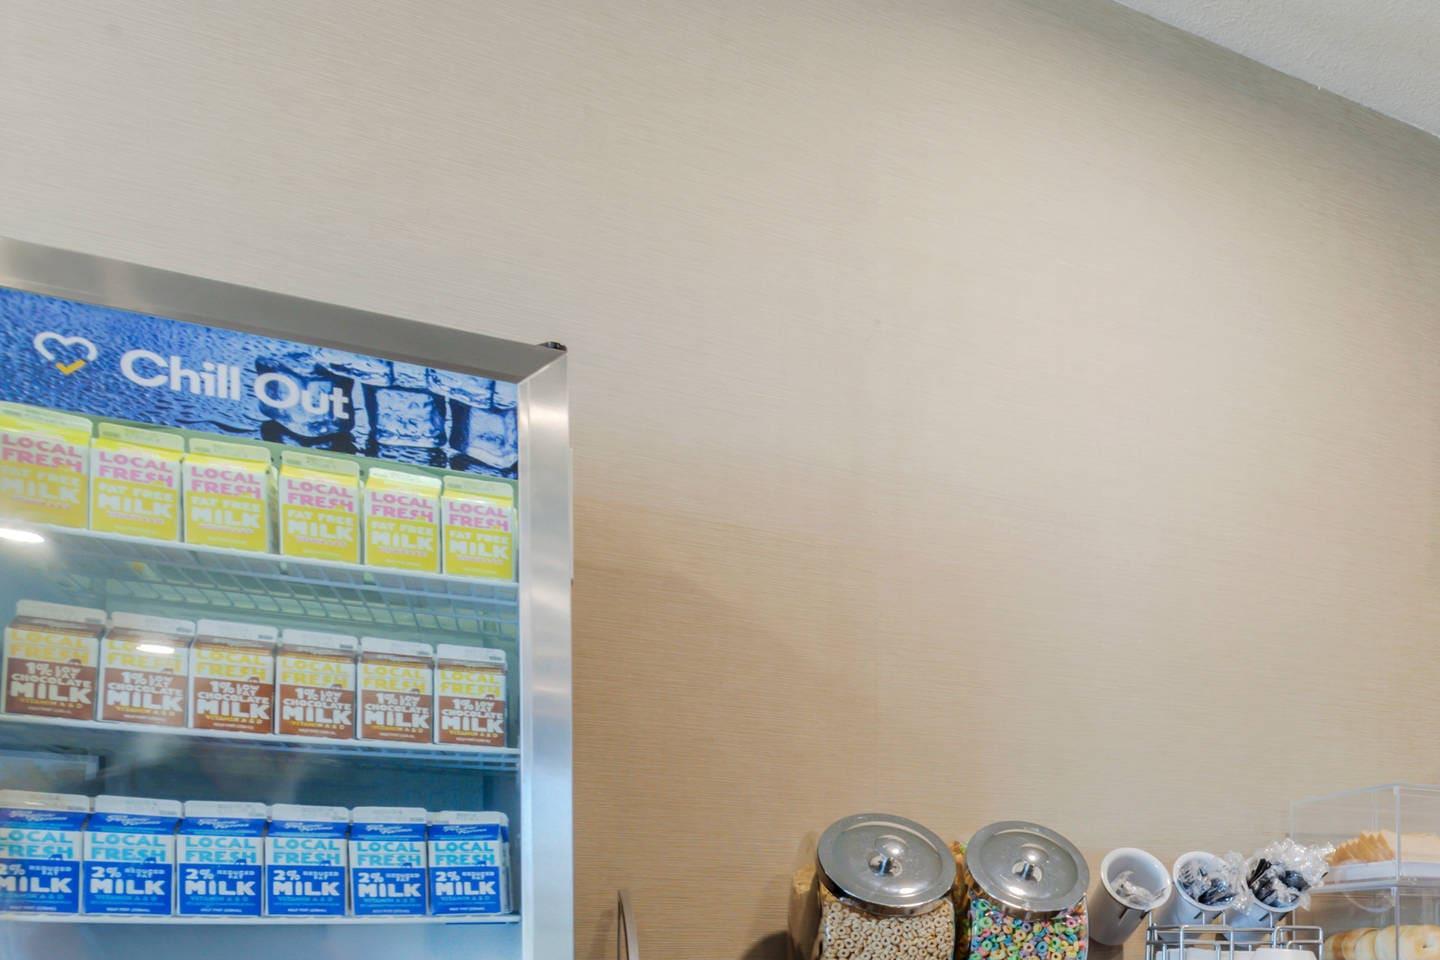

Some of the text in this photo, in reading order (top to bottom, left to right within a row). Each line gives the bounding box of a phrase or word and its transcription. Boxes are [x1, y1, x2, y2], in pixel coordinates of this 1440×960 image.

[120, 349, 348, 420] Chill Out
[2, 434, 82, 458] LOCAL
[99, 451, 173, 472] LOCAL
[191, 466, 261, 485] LOCAL
[0, 476, 80, 505] MILK
[288, 479, 353, 498] LOCAL
[99, 493, 173, 518] MILK
[371, 491, 433, 509] LOCAL
[449, 501, 508, 518] LOCAL
[191, 506, 261, 529] MILK
[287, 519, 353, 542] MILK
[371, 531, 433, 552] MILK
[450, 539, 509, 559] MILK
[11, 631, 86, 648] LOCAL
[196, 648, 265, 666] LOCAL
[282, 656, 345, 673] LOCAL
[26, 662, 53, 677] 1%
[363, 665, 425, 679] LOCAL
[441, 670, 500, 683] LOCAL
[11, 673, 92, 688] CHOCOLATE
[121, 672, 147, 685] 1%
[10, 681, 92, 704] MILK
[107, 682, 183, 697] CHOCOLATE
[209, 681, 234, 693] 1%
[295, 688, 318, 700] 1%
[106, 689, 183, 712] MILK
[198, 691, 269, 705] CHOCOLATE
[283, 698, 352, 711] CHOCOLATE
[376, 693, 399, 705] 1%
[453, 699, 474, 710] 1%
[197, 699, 270, 720] MILK
[283, 704, 352, 725] MILK
[365, 704, 430, 715] CHOCOLATE
[442, 709, 503, 720] CHOCOLATE
[364, 710, 430, 729] MILK
[442, 716, 504, 733] MILK
[91, 833, 166, 847] LOCAL
[185, 836, 256, 849] LOCAL
[273, 838, 340, 850] LOCAL
[357, 842, 421, 852] LOCAL
[435, 841, 494, 852] LOCAL
[91, 847, 166, 862] FRESH
[185, 850, 256, 864] FRESH
[273, 851, 340, 865] FRESH
[357, 854, 421, 866] FRESH
[435, 854, 495, 865] FRESH
[0, 863, 26, 875] 2%
[90, 866, 122, 878] 2%
[185, 868, 214, 880] 2%
[273, 869, 300, 881] 2%
[435, 871, 460, 882] 2%
[0, 876, 72, 894] MILK
[358, 872, 384, 883] 2%
[89, 878, 165, 896] MILK
[185, 880, 256, 896] MILK
[273, 881, 340, 896] MILK
[358, 883, 422, 898] MILK
[435, 881, 496, 896] MILK
